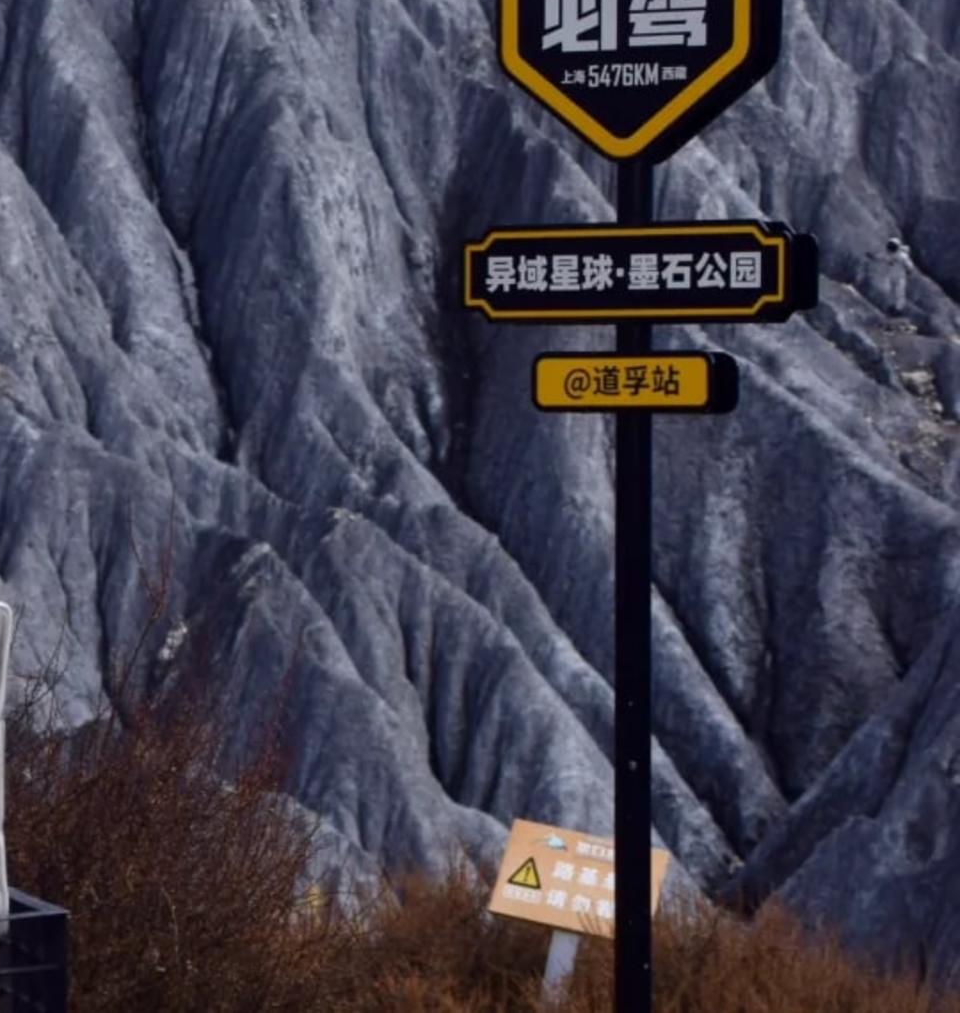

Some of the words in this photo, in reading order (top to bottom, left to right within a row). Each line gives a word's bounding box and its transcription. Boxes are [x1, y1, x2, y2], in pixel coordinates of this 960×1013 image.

[588, 63, 659, 87] 5476KM
[486, 252, 762, 292] 异域星球·墨石公园
[564, 365, 680, 399] @道孚站
